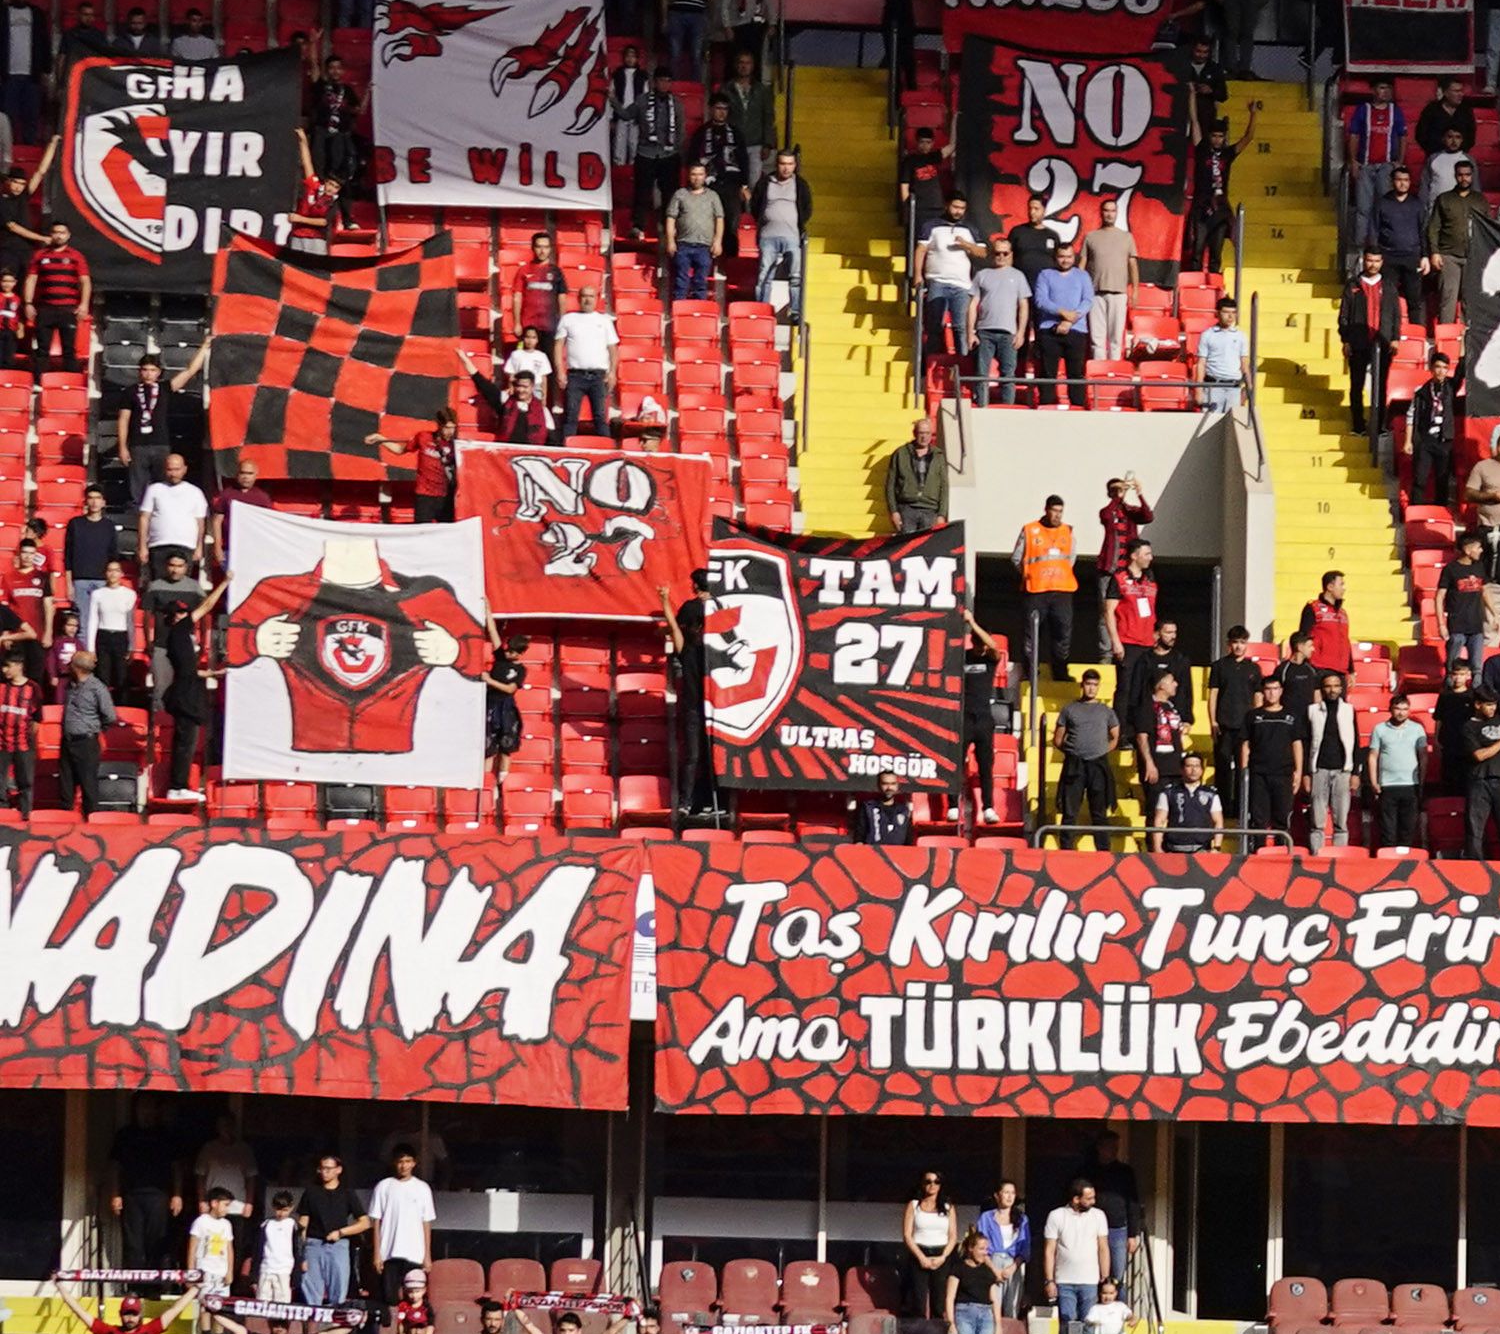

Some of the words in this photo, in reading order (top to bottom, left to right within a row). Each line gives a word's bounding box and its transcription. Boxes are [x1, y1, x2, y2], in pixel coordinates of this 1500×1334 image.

[172, 65, 244, 102] HA
[1013, 59, 1154, 148] NO
[168, 130, 263, 178] YIR
[376, 148, 432, 185] BE
[470, 143, 607, 191] WİLD
[511, 455, 655, 523] NO
[541, 517, 655, 575] 27
[809, 556, 956, 608] TAM
[336, 622, 369, 635] GFK
[780, 725, 875, 752] ULTRAS
[724, 880, 860, 974] Taş
[889, 884, 1124, 968] Kırılır
[1140, 887, 1332, 985] Tunç
[688, 997, 849, 1064] Ama
[859, 983, 1202, 1074] TÜRKLÜK
